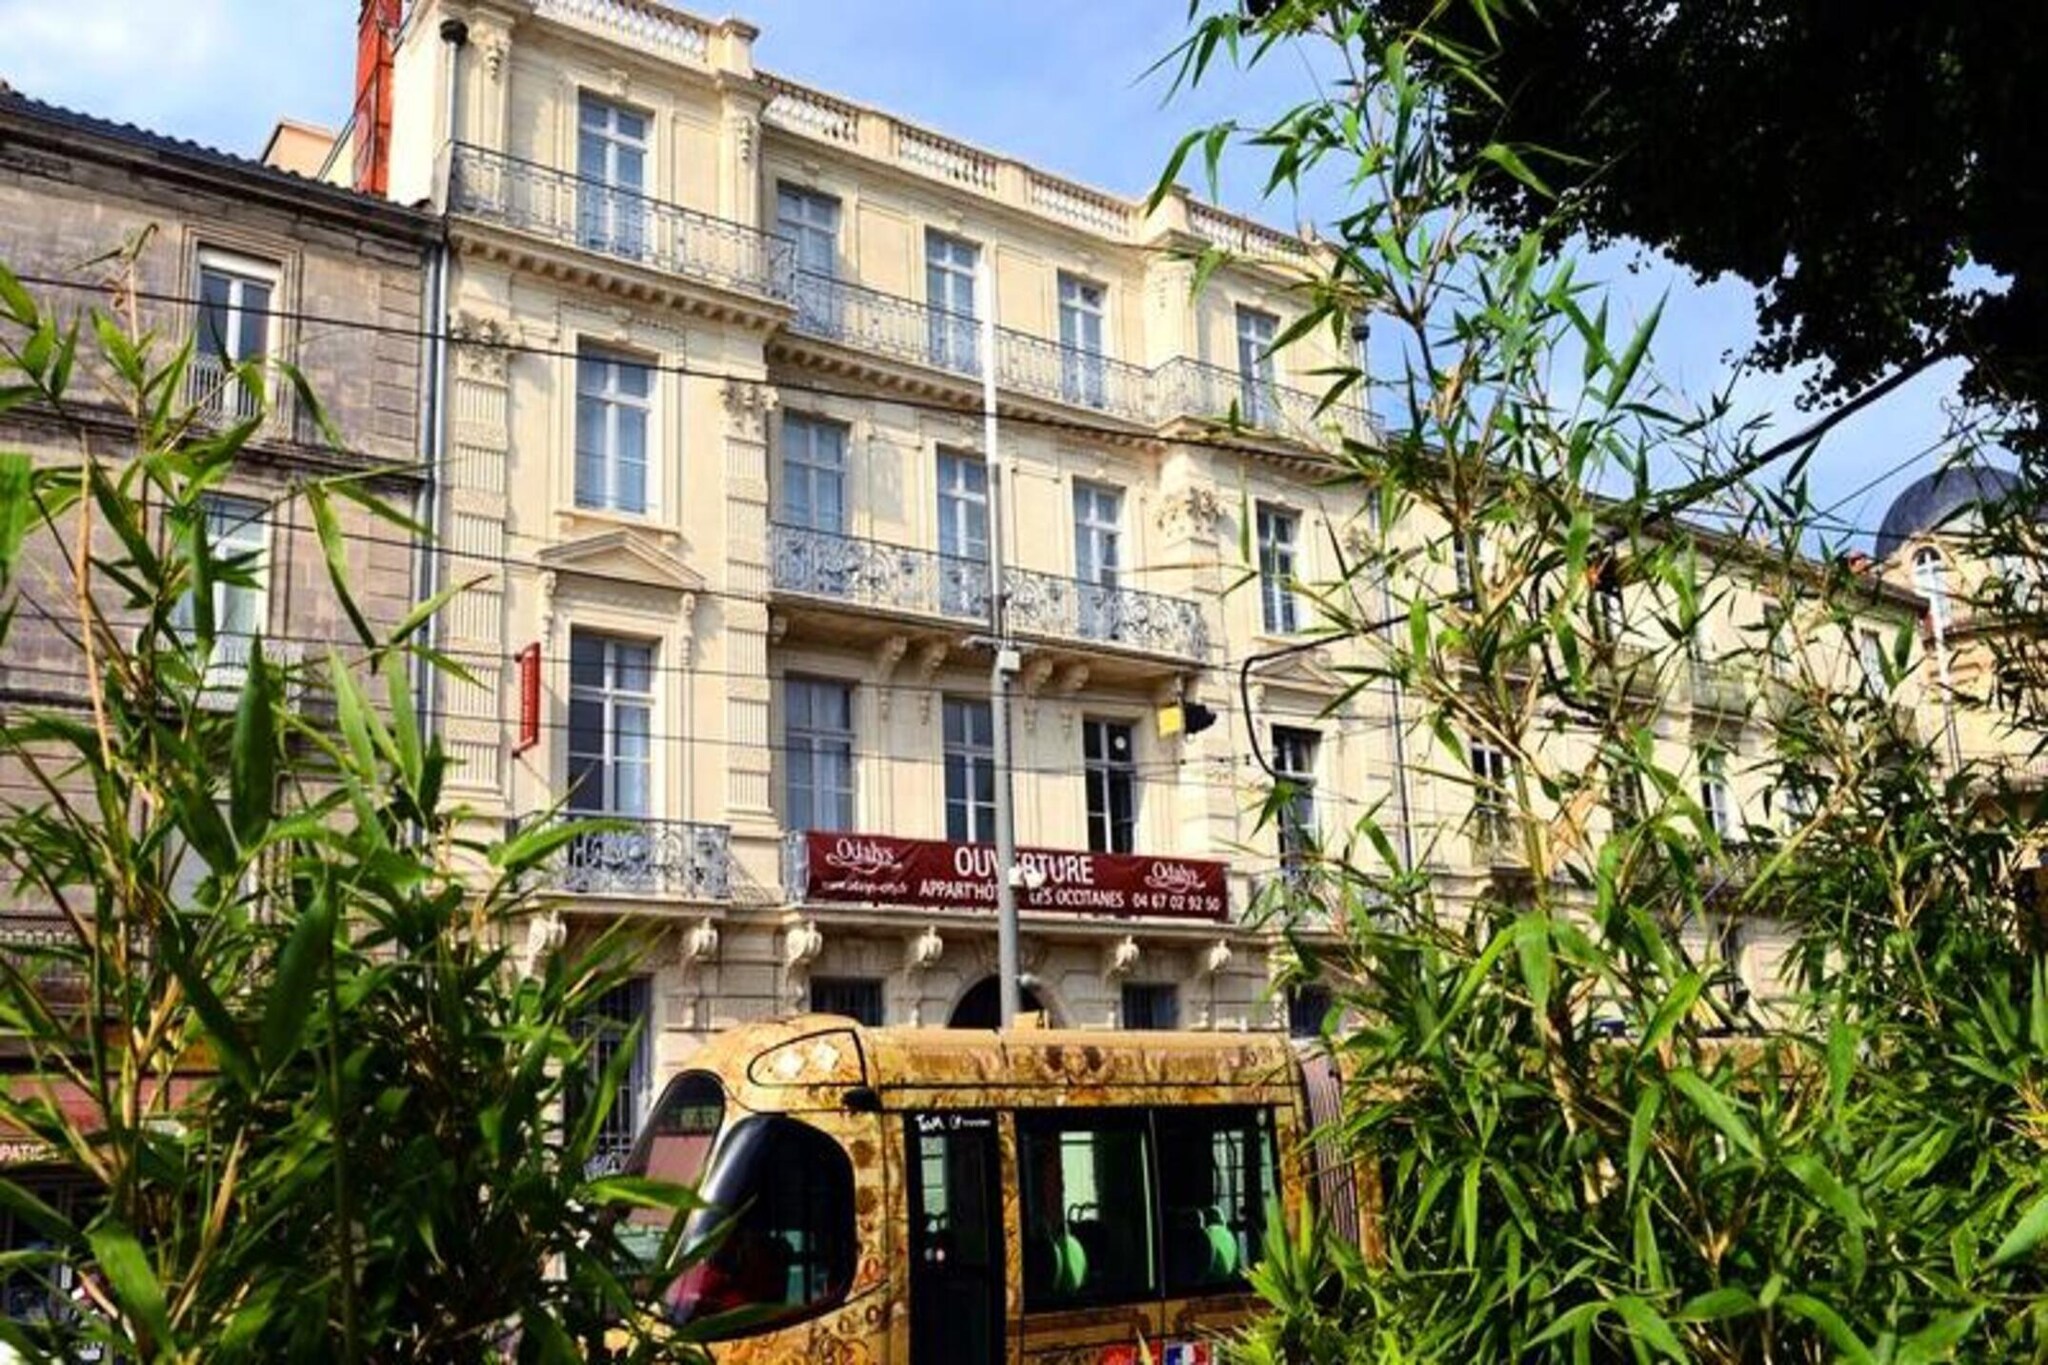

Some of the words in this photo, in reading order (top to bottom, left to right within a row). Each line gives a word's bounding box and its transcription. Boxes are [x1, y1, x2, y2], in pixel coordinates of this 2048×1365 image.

[1055, 887, 1125, 908] OCCITANES
[1132, 892, 1148, 908] 04
[1152, 893, 1166, 909] 67
[1170, 894, 1185, 910] 02
[1188, 895, 1203, 911] 92
